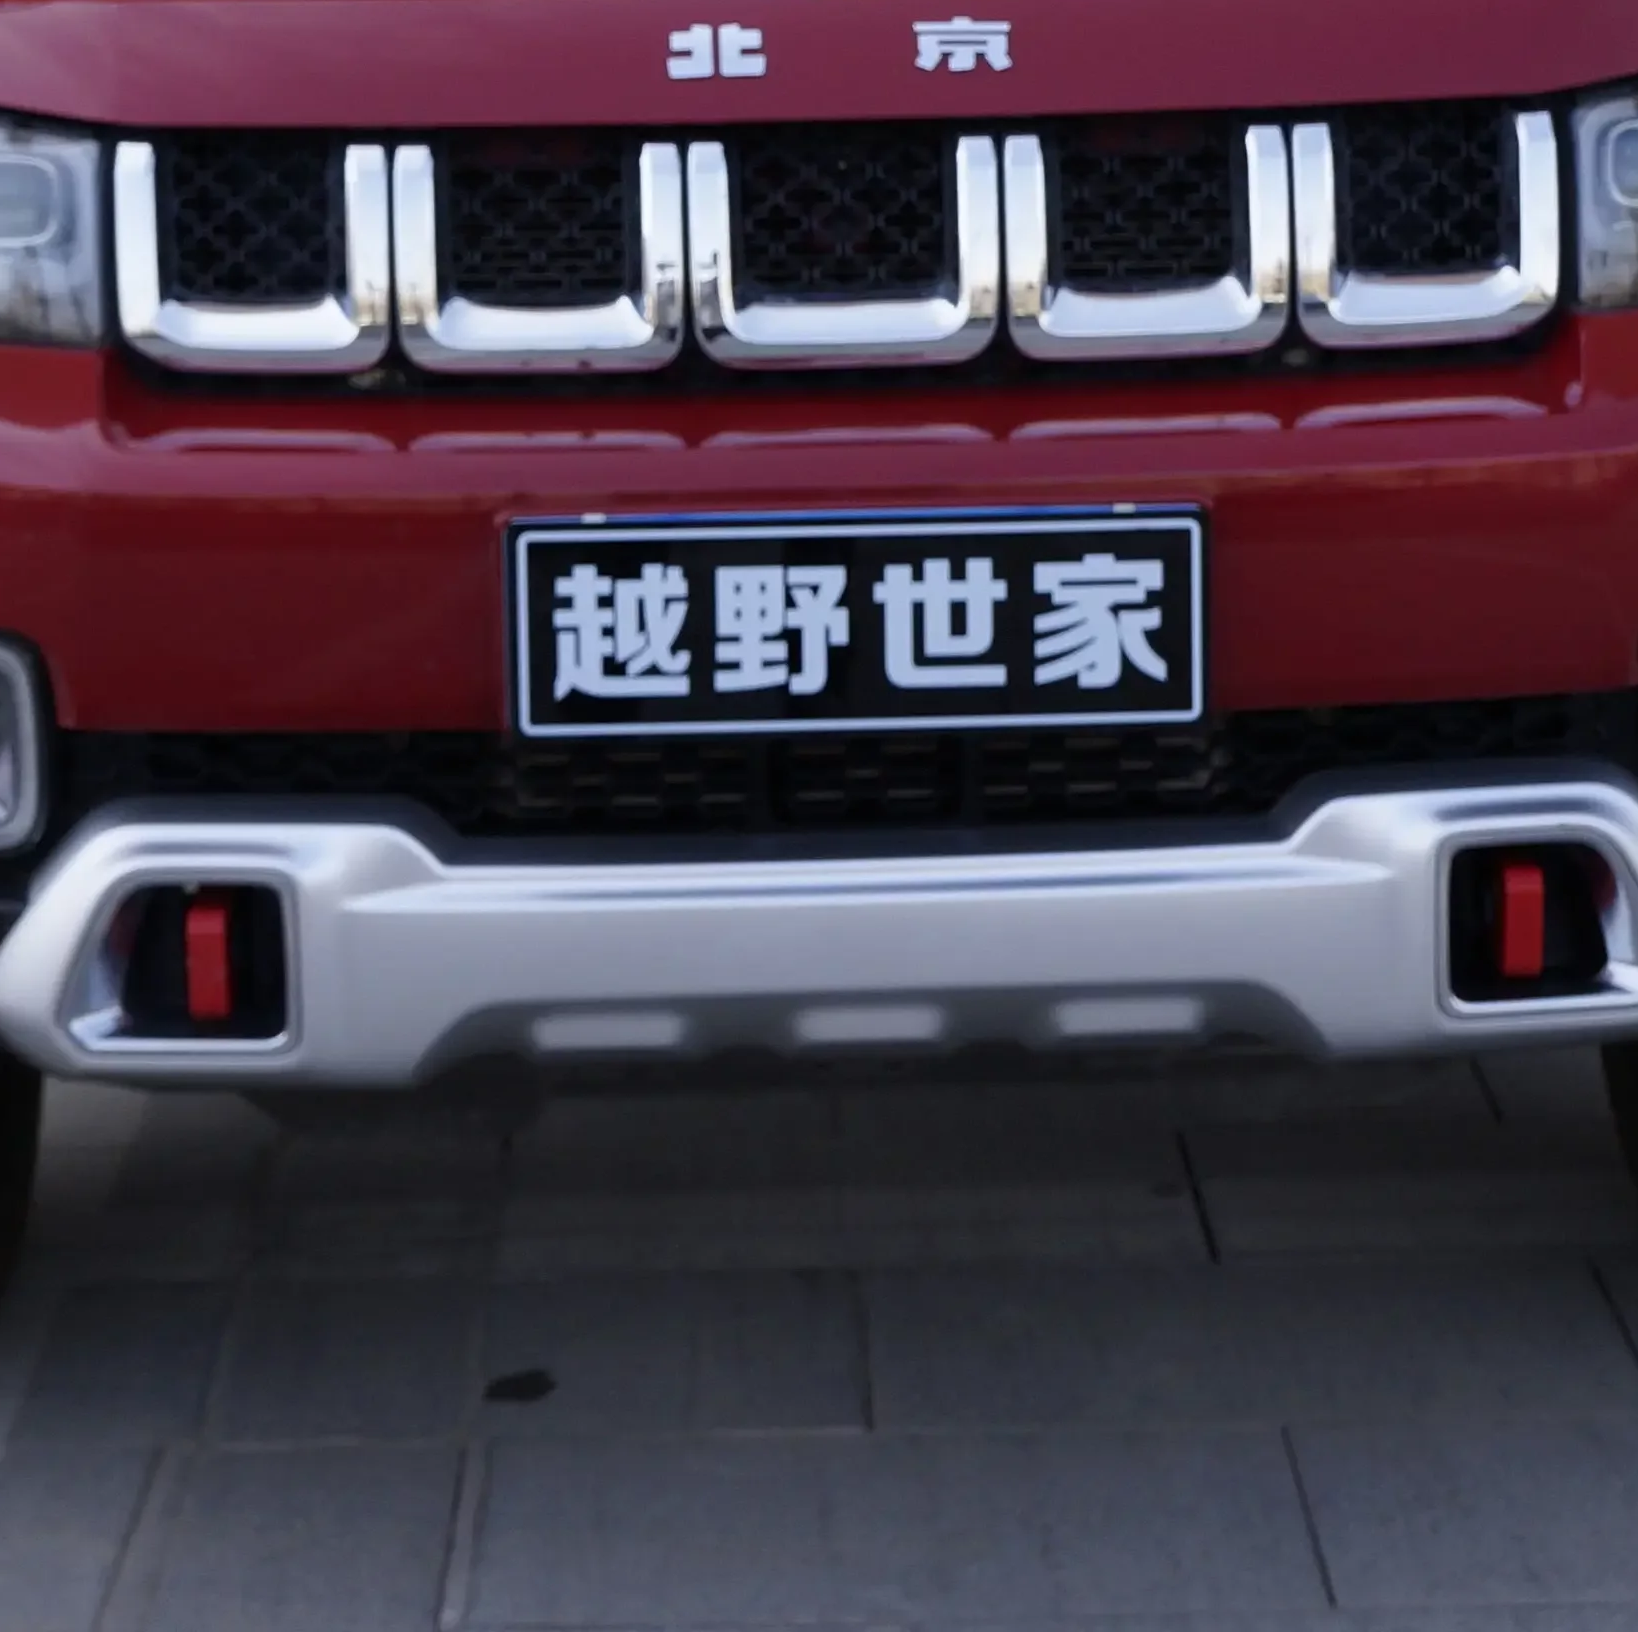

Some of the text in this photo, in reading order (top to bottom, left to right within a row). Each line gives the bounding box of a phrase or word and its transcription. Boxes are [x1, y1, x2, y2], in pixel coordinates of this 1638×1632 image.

[666, 15, 1013, 79] 北京
[553, 553, 1167, 702] 越野世家
